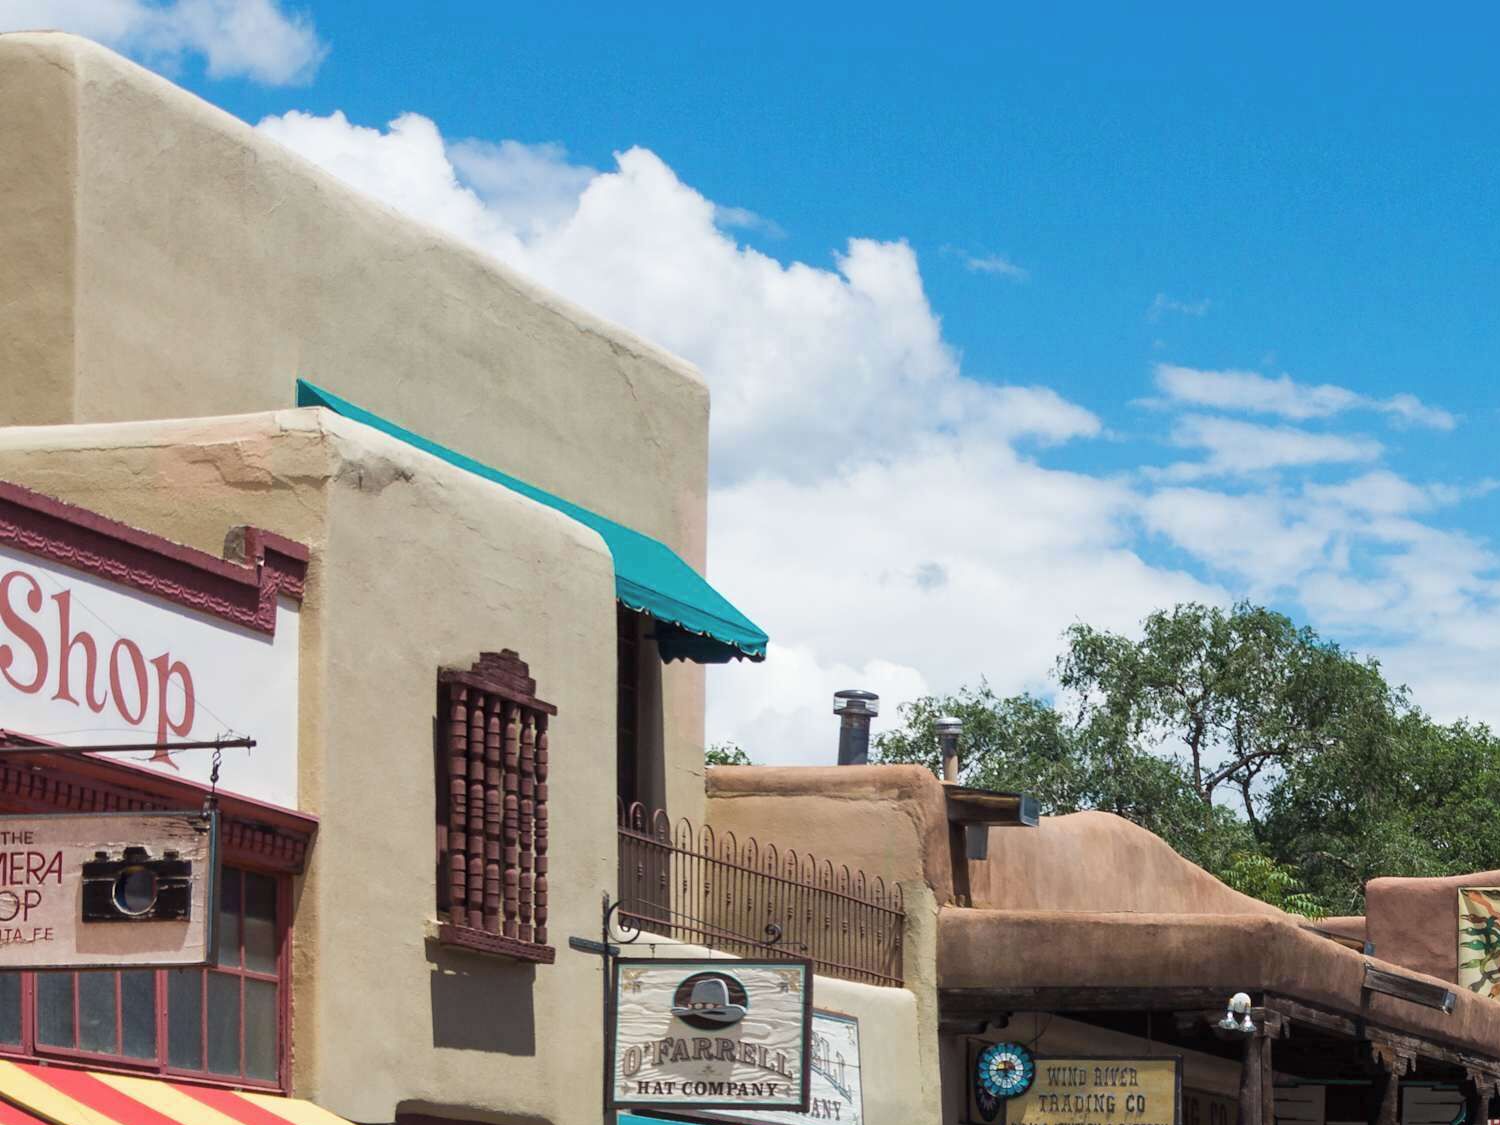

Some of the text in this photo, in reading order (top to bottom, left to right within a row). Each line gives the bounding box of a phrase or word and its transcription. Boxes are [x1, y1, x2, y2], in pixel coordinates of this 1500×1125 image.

[0, 570, 196, 771] Shop
[0, 831, 34, 845] THE
[33, 928, 54, 941] FE
[622, 1037, 794, 1079] O'FARRELL
[1046, 1067, 1139, 1087] WIND RIVER
[637, 1081, 779, 1097] HAT COMPANY
[1039, 1094, 1146, 1114] TRADING CO
